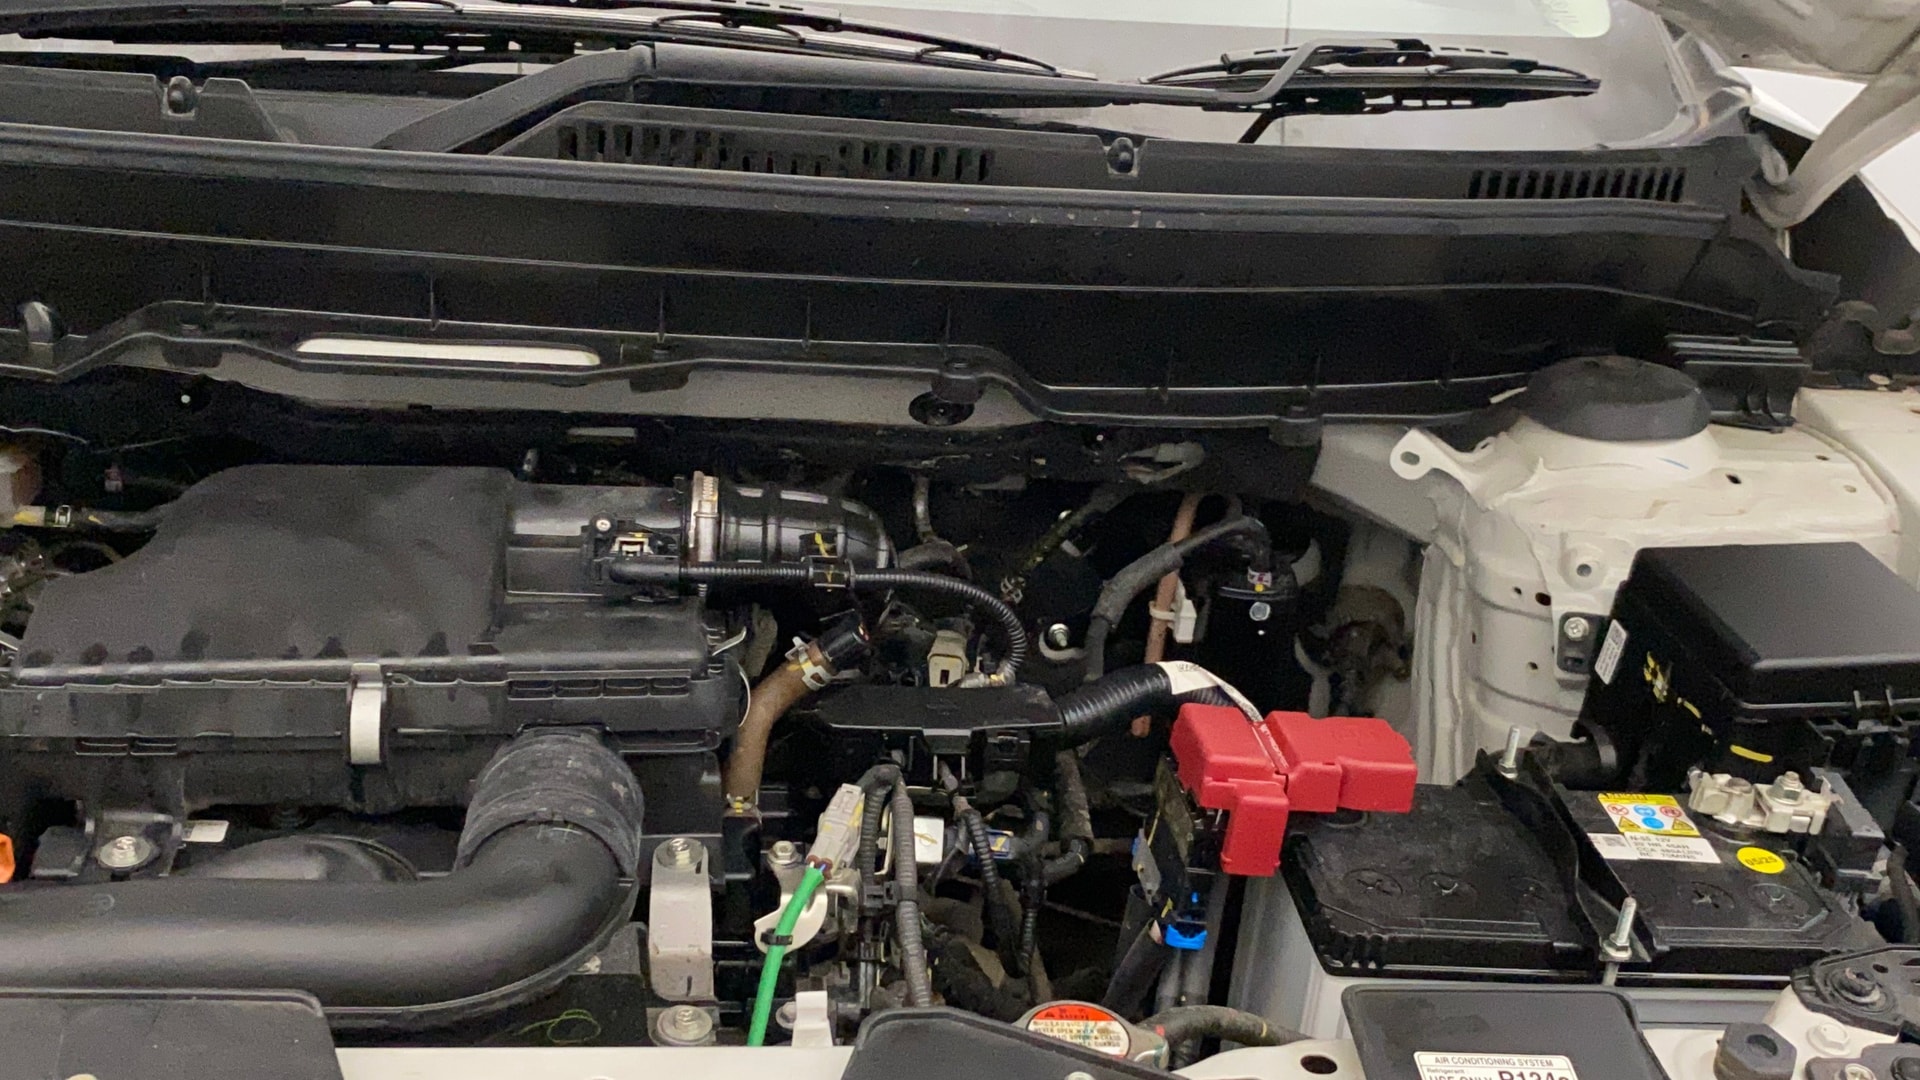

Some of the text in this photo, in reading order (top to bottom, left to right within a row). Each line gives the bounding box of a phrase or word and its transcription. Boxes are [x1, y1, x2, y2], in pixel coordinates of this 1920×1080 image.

[1435, 1056, 1554, 1067] AIR CONDITIONING SYSTEM
